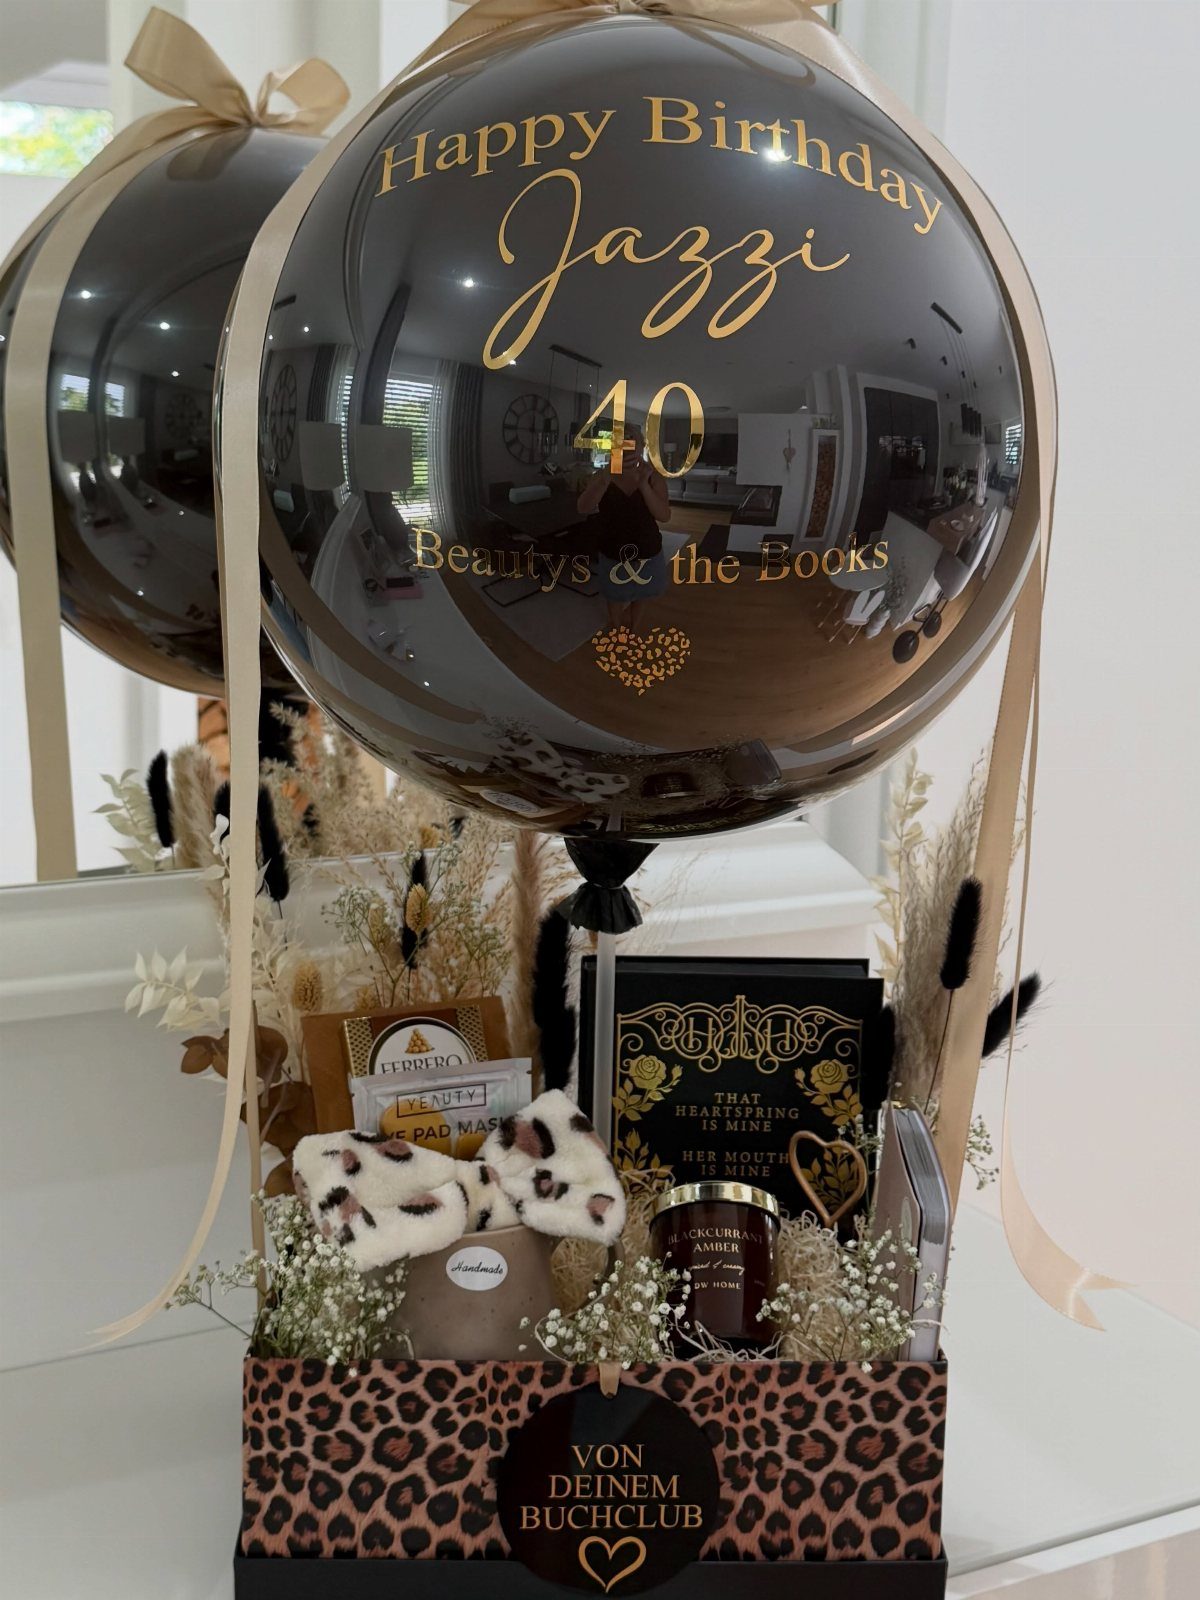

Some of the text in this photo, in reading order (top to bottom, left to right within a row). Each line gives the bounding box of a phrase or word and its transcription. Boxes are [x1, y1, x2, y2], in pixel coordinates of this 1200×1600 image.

[375, 96, 943, 234] Happy Birthday
[483, 168, 850, 370] Jazzi
[574, 379, 705, 478] 40
[411, 527, 889, 592] Beautys & the Books
[381, 1054, 463, 1074] FERRERO
[715, 1092, 761, 1104] THAT
[675, 1105, 799, 1119] HEARTSPRING
[414, 1124, 451, 1141] PAD
[458, 1117, 504, 1135] MAS
[702, 1120, 772, 1132] IS MINE
[682, 1150, 789, 1164] HER MOUTH
[701, 1165, 771, 1177] IS MINE
[668, 1228, 763, 1245] BLACKCURRANT
[693, 1242, 740, 1253] AMBER
[451, 1260, 504, 1275] Handmade
[694, 1282, 709, 1290] DW
[713, 1281, 742, 1290] HOME
[571, 1443, 645, 1469] VON
[548, 1474, 681, 1499] DEINEM
[519, 1504, 704, 1531] BUCHCLUB
